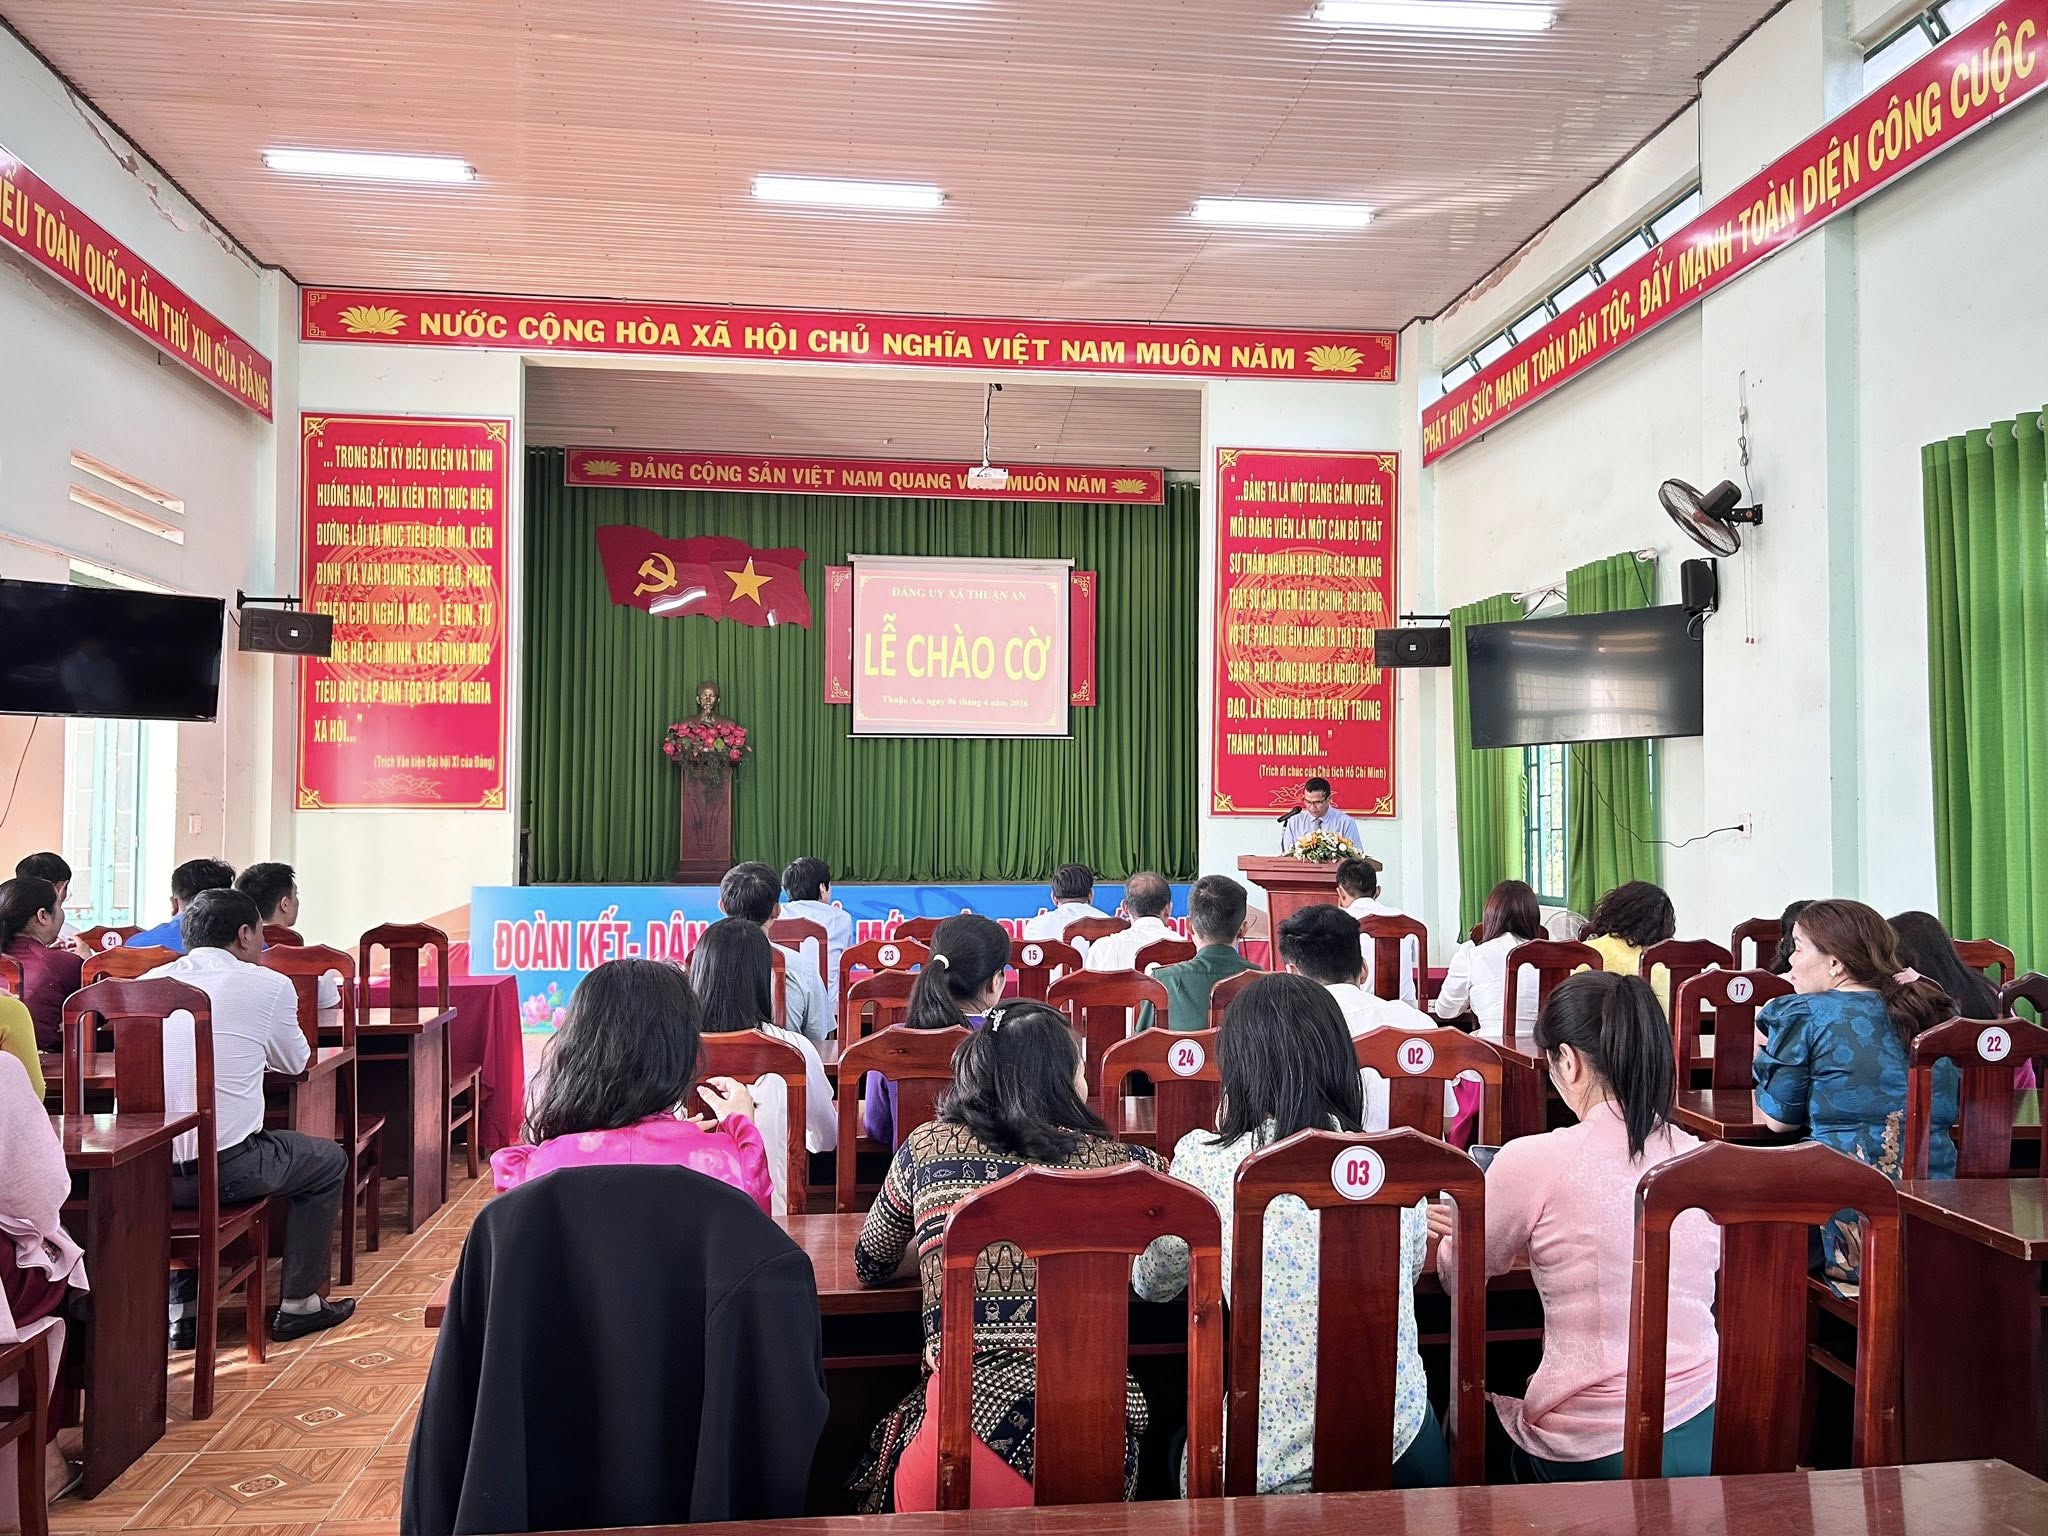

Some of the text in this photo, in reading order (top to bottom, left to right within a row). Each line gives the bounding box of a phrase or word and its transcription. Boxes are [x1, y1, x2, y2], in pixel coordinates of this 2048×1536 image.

[1423, 18, 2036, 456] PHÁT HUY SỨC MẠNH TOÀN DÂN TỘC, ĐẨY MẠNH TOÀN DIỆN CÔNG CUỘC
[34, 202, 80, 276] TOÀN
[85, 248, 126, 309] QUỐC
[131, 270, 159, 333] LẦN
[162, 301, 188, 353] THỨ
[192, 323, 212, 370] XIII
[214, 335, 237, 389] CỦA
[239, 353, 270, 410] ĐẢNG
[420, 311, 1295, 370] NƯỚC CỘNG HÒA XÃ HỘI CHỦ NGHĨA VIỆT NAM MUÔN NĂM
[335, 445, 368, 468] TRONG
[371, 439, 388, 469] BẤT
[391, 442, 403, 469] KỲ
[431, 444, 453, 475] KIỆN
[456, 444, 468, 471] VÀ
[470, 445, 493, 472] TÌNH
[630, 456, 684, 480] ĐẢNG
[690, 460, 742, 484] CỘNG
[748, 460, 786, 484] SẢN
[792, 464, 835, 488] VIỆT
[842, 469, 883, 487] NAM
[889, 471, 951, 490] QUANG
[1007, 472, 1060, 492] MUÔN
[1066, 474, 1106, 494] NĂM
[317, 476, 350, 507] HUỐNG
[377, 478, 400, 508] PHẢI
[402, 481, 425, 509] KIÊN
[427, 482, 442, 509] TRÌ
[444, 485, 468, 514] THỰC
[470, 483, 493, 515] HIỆN
[1230, 509, 1382, 546] MỖI ĐẢNG VIÊN LÀ MỘT CÁN BỘ THẬT
[864, 613, 1051, 681] LỄ CHÀO CỜ
[1227, 728, 1300, 756] THÀNH CỦA NHÂN
[108, 936, 117, 946] 21
[494, 910, 570, 970] ĐOÀN
[884, 950, 894, 960] 23
[1028, 950, 1037, 960] 15
[1734, 983, 1746, 996] 17
[1178, 1048, 1195, 1066] 24
[1408, 1047, 1424, 1065] 02
[1987, 1036, 2001, 1052] 22
[1346, 1159, 1370, 1185] 03
